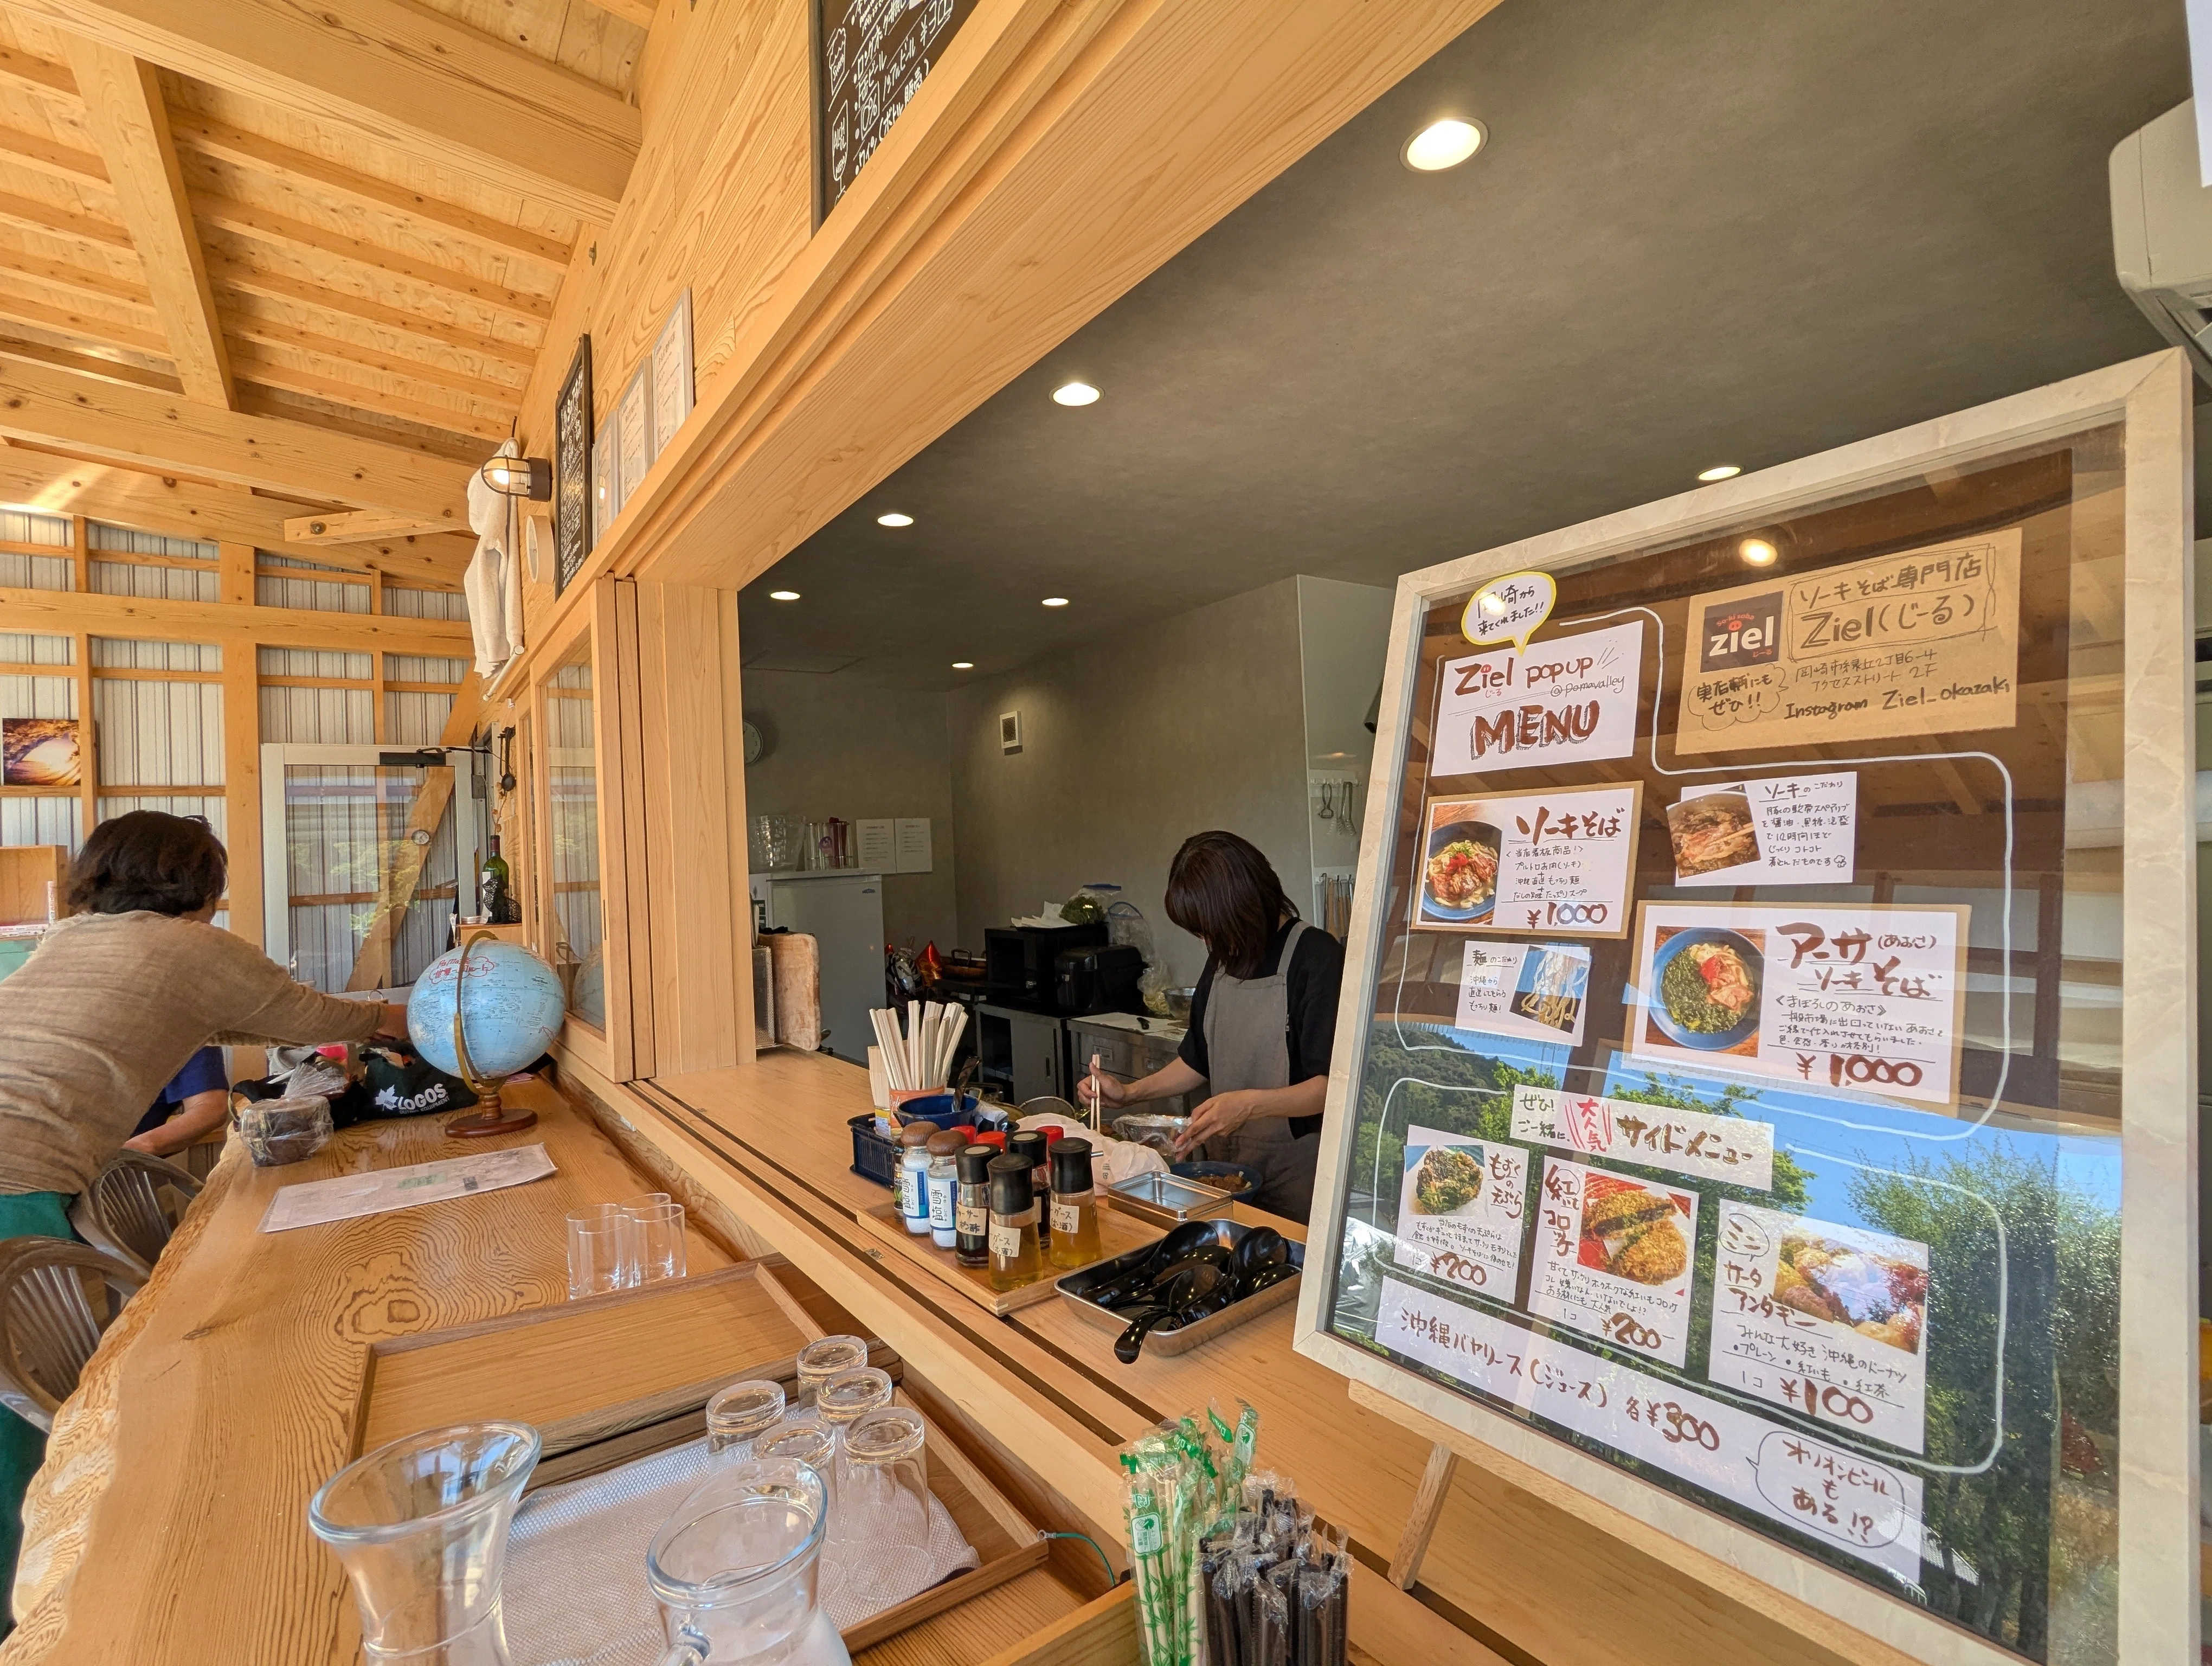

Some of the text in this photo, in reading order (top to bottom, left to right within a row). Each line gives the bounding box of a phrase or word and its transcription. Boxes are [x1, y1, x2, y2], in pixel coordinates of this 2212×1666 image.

[863, 93, 877, 131] 0%
[1799, 552, 1982, 610] ソーキそば専門店
[1709, 616, 1774, 657] ziel
[1454, 657, 1514, 697] Ziel
[1784, 697, 1868, 721] Instagram
[1470, 700, 1600, 761] MENU
[1516, 806, 1625, 845] ソーキそば
[1470, 976, 1498, 985] 沖縄から
[1815, 956, 1944, 998] ソーキそば
[398, 1083, 446, 1110] LOGOS
[1577, 1097, 1607, 1153] 大人気
[1616, 1114, 1754, 1165] サイドメニュー
[1489, 1152, 1521, 1181] もずく
[1506, 1180, 1514, 1189] の
[1491, 1184, 1523, 1219] 天ぷら
[1430, 1251, 1487, 1286] ¥200
[1780, 1377, 1874, 1424] ¥100
[1783, 1439, 1889, 1496] オリオンビール
[1822, 1478, 1839, 1500] も
